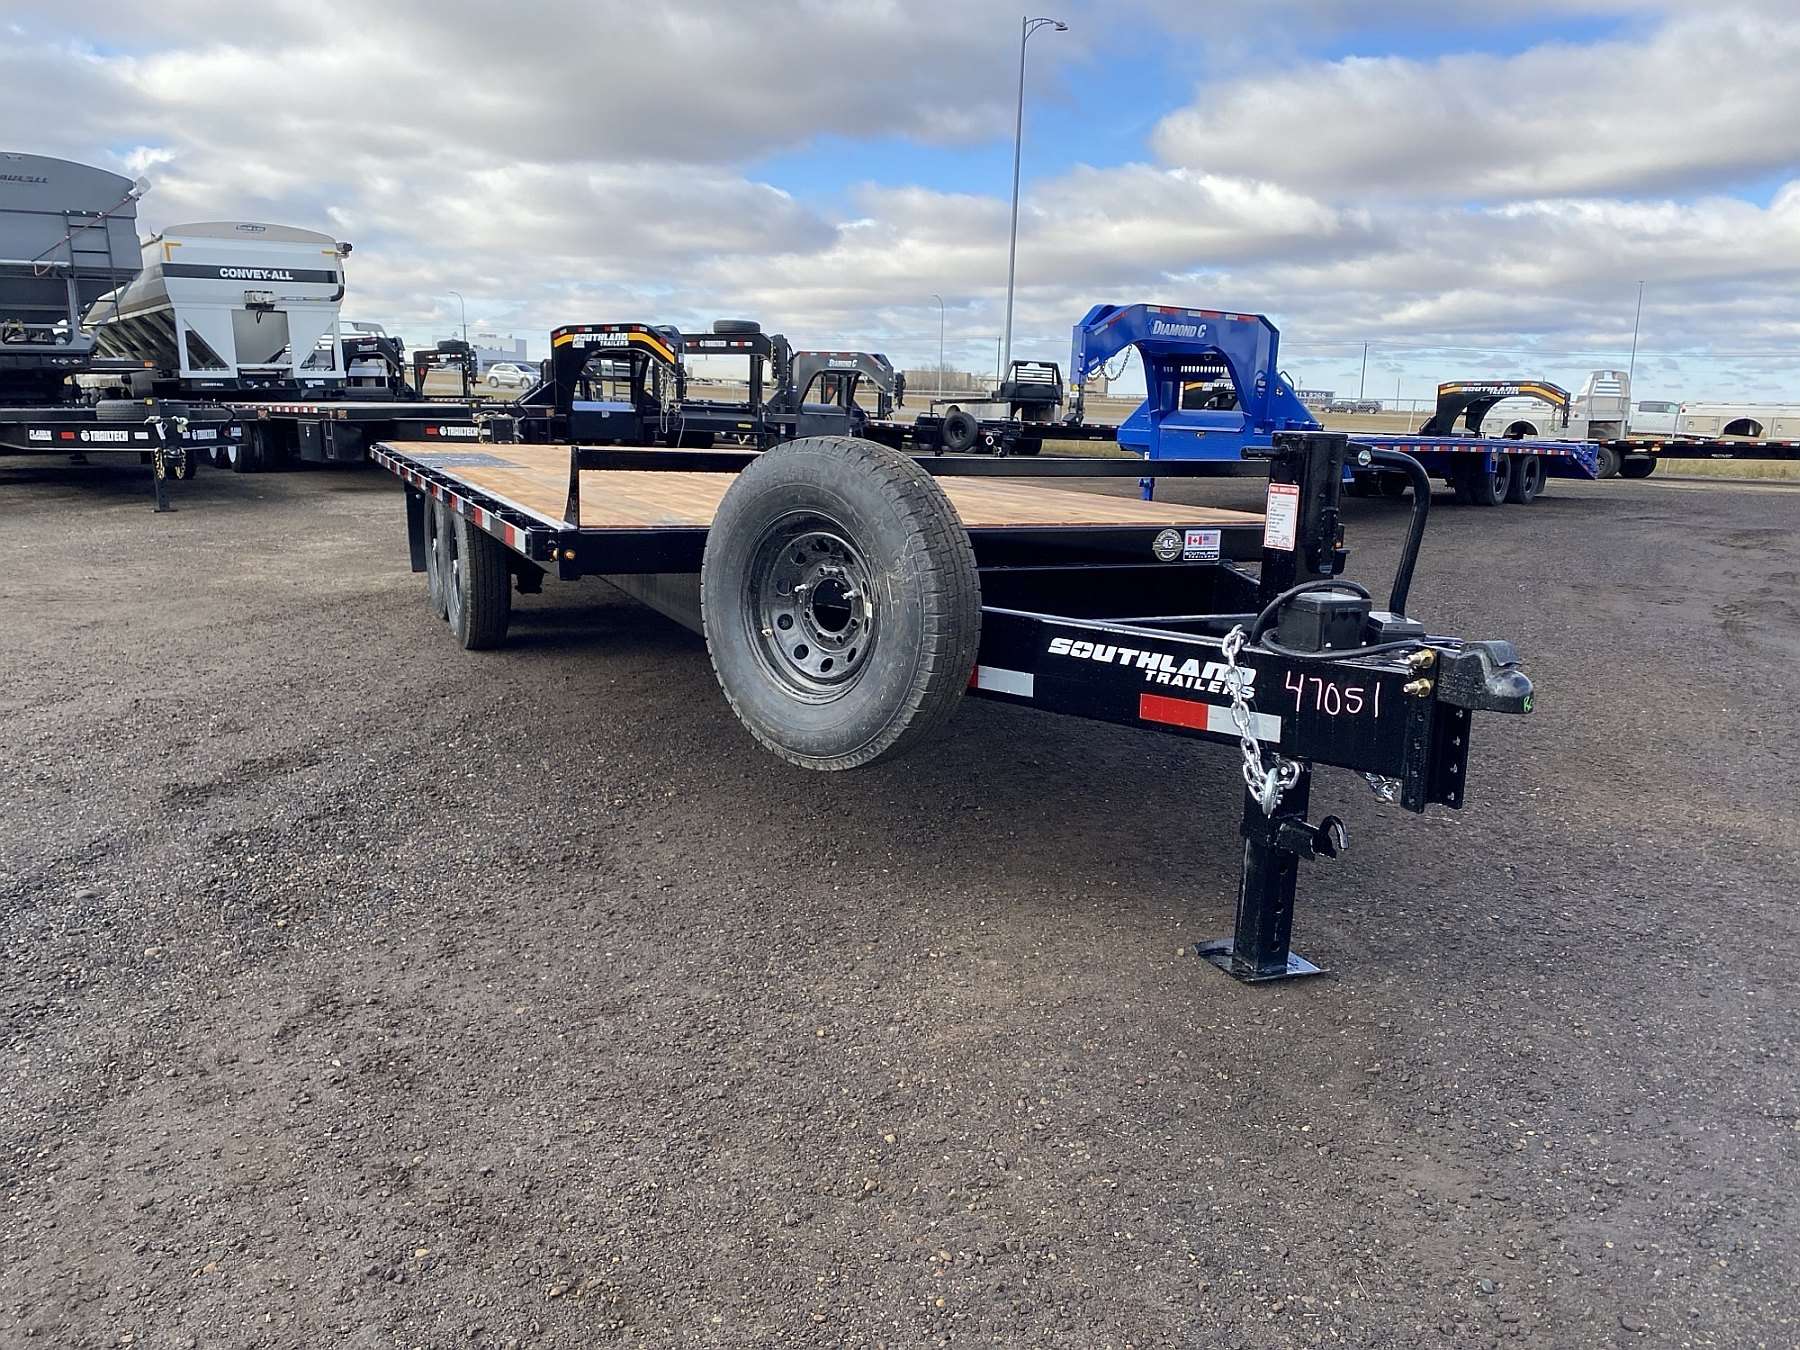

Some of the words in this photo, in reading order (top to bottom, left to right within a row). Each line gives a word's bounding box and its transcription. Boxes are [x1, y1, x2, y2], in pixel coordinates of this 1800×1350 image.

[220, 268, 293, 280] CONVEY-ALL
[573, 333, 628, 341] SOUTHLAND
[1153, 320, 1196, 336] DIAMOND
[1198, 324, 1207, 337] C
[1048, 637, 1257, 684] SOUTHLAND
[1286, 671, 1380, 718] 47051
